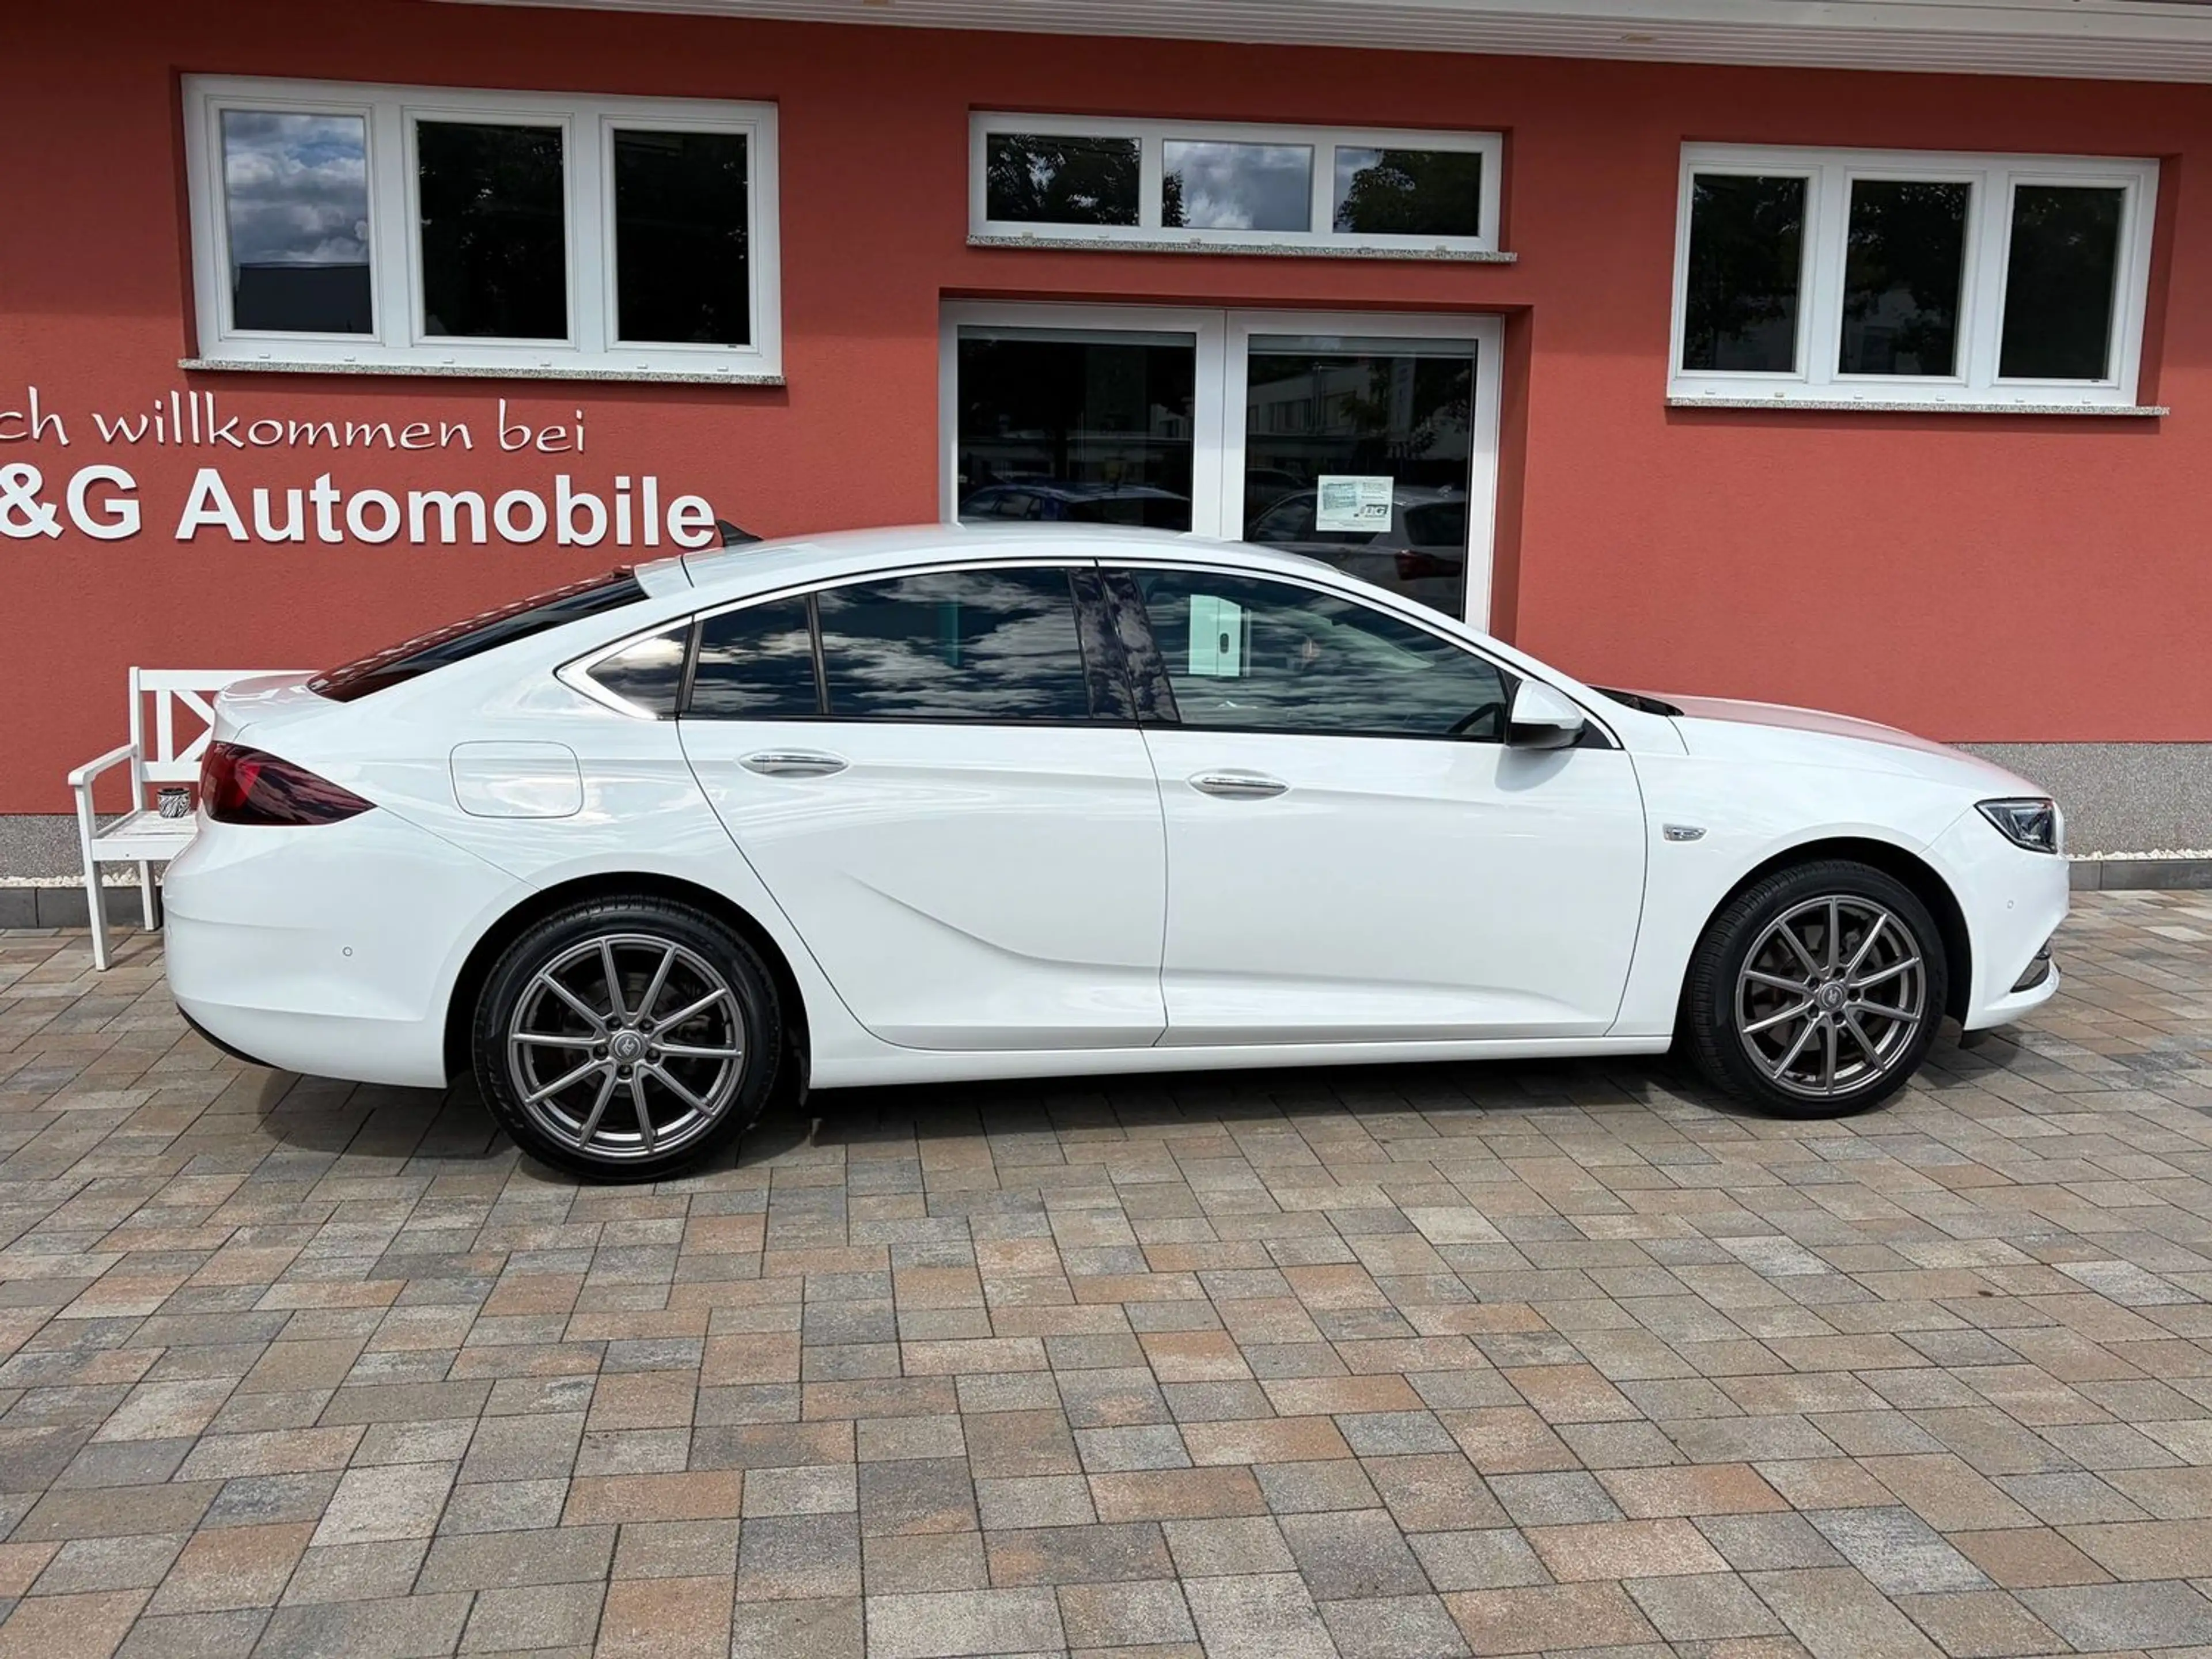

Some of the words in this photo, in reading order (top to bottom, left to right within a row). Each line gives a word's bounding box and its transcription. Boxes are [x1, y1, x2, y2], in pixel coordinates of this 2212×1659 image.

[92, 391, 474, 449] willkommen
[499, 398, 584, 452] bei
[0, 463, 141, 540] &G
[175, 468, 715, 548] Automobile
